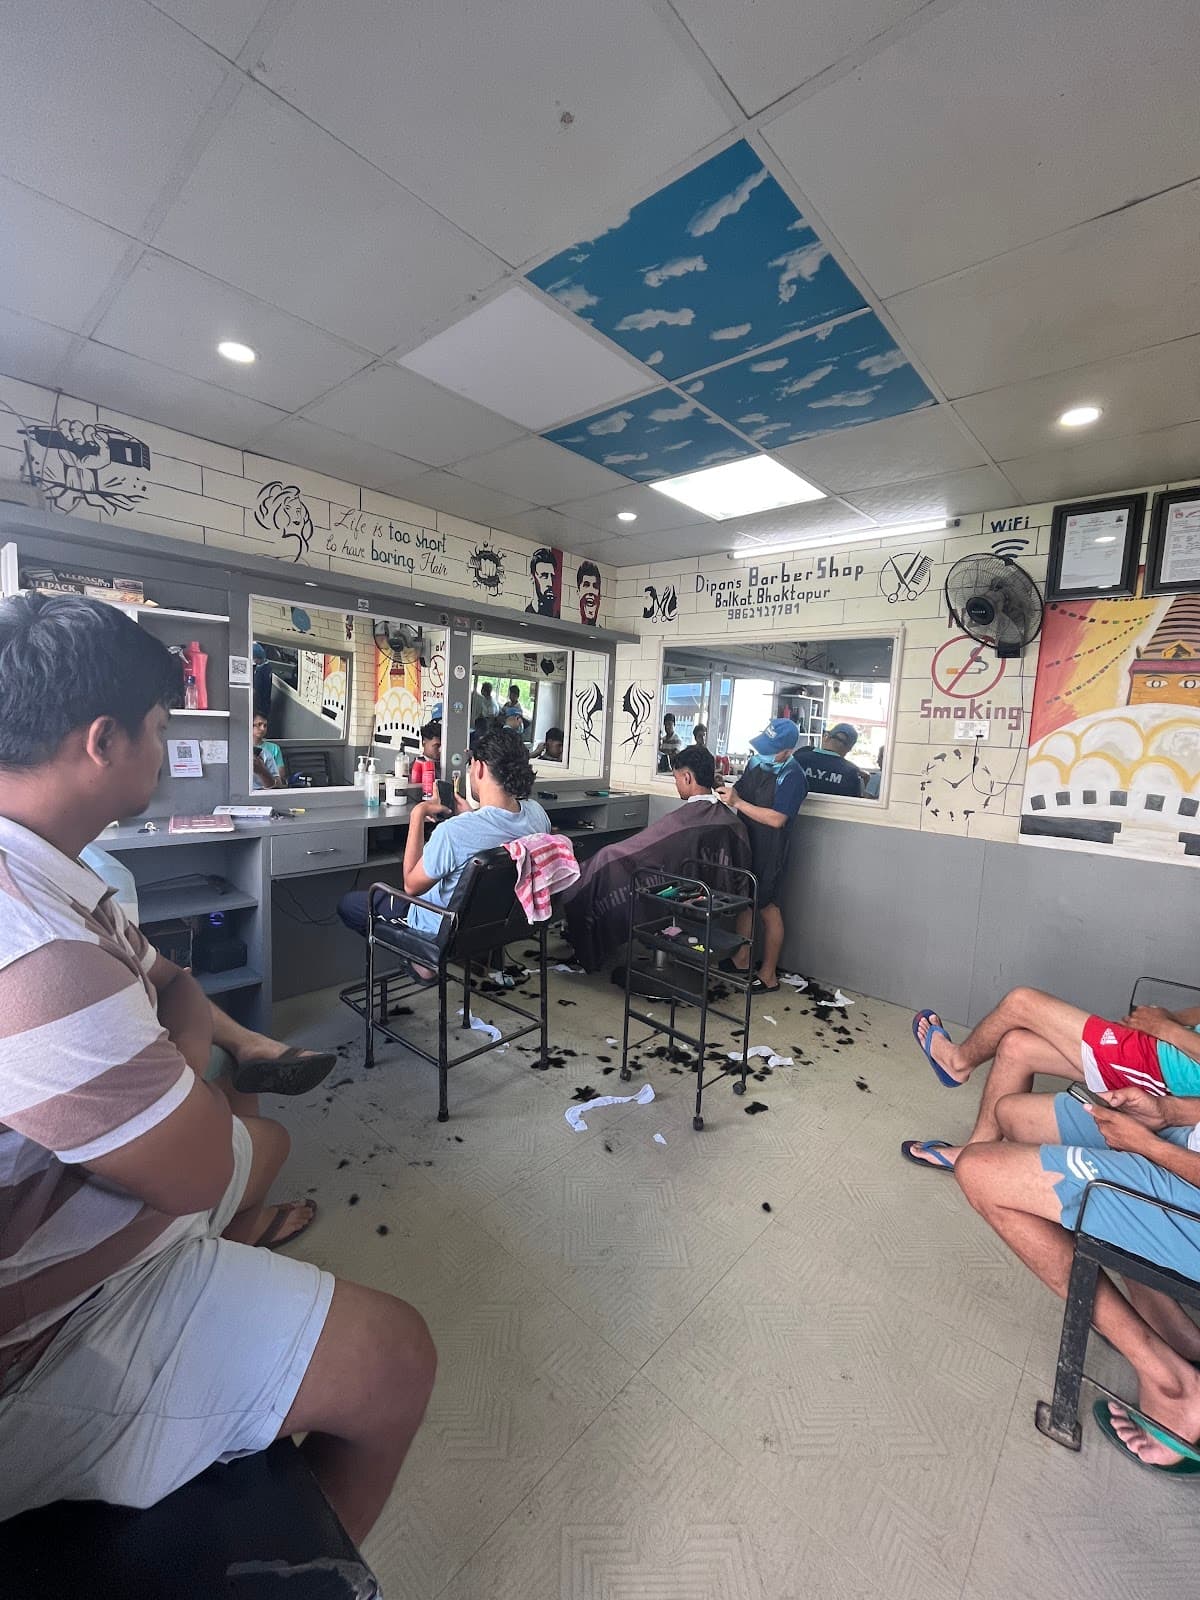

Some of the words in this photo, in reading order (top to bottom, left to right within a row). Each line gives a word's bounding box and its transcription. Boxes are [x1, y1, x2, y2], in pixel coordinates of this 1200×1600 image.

[334, 508, 367, 540] Life
[373, 522, 383, 538] is
[388, 521, 411, 544] too
[415, 529, 447, 553] short
[990, 516, 1030, 534] WiFi
[371, 539, 415, 574] boring
[421, 552, 448, 576] Hair
